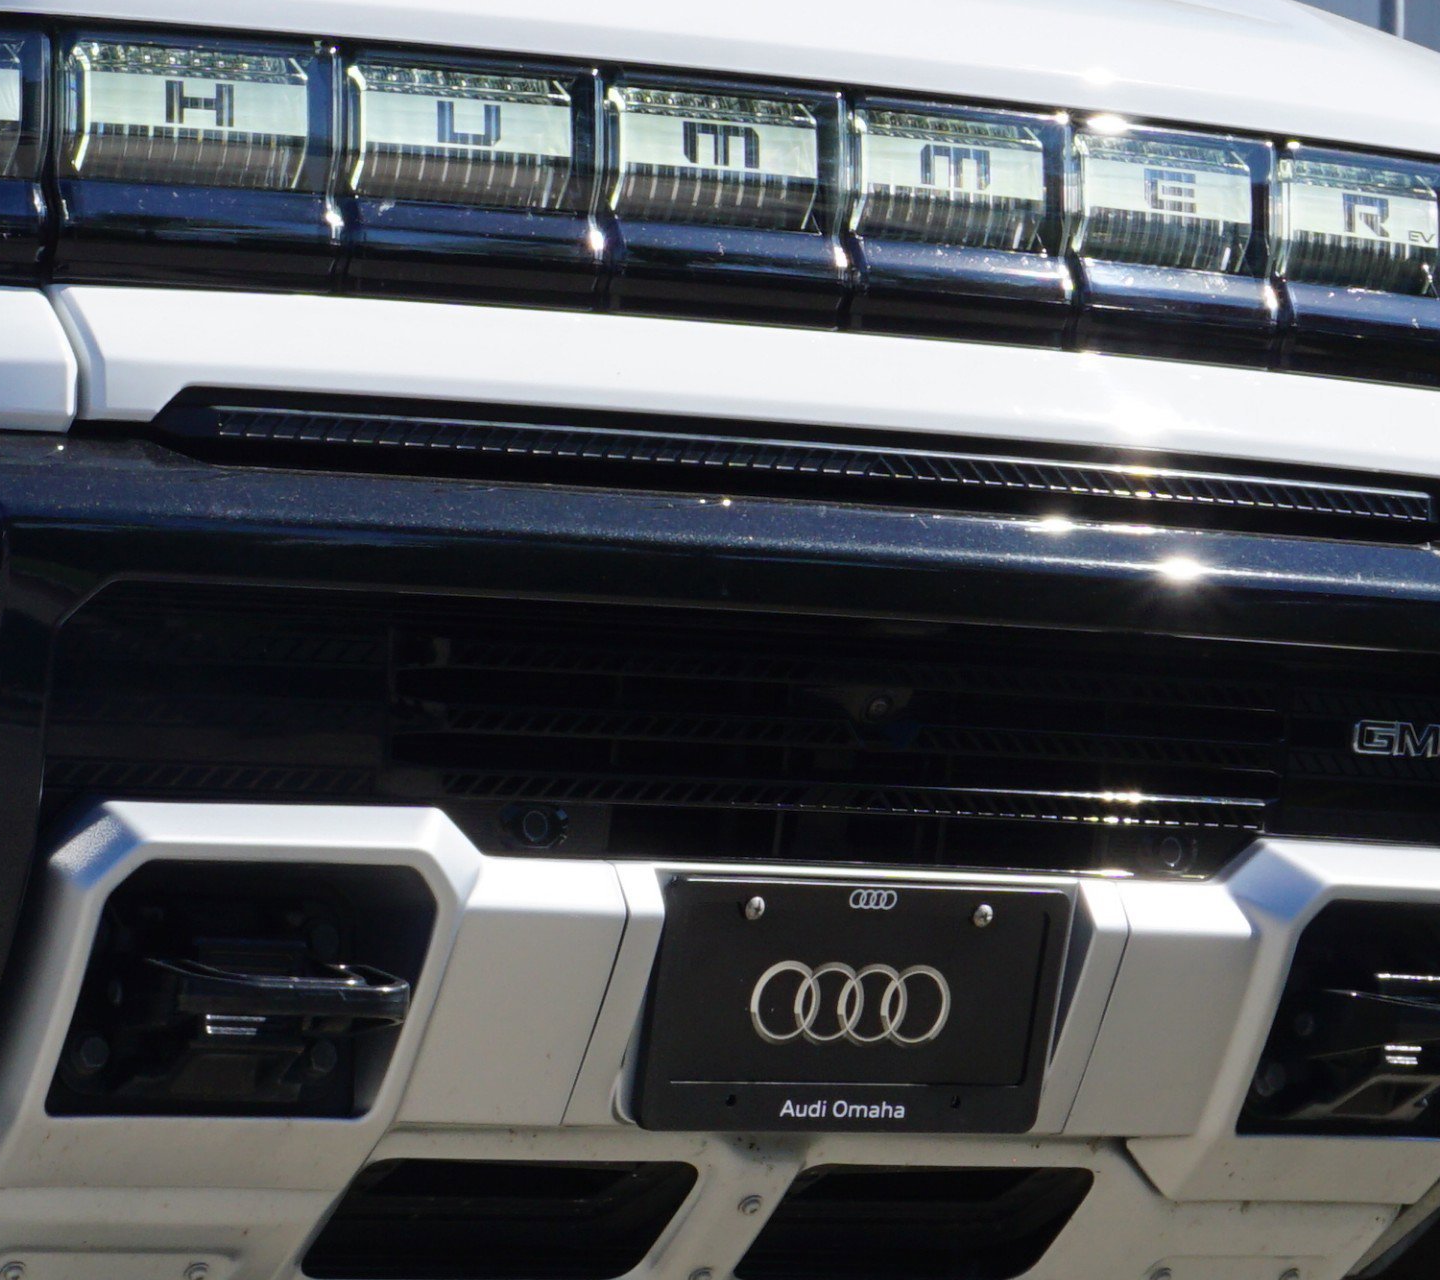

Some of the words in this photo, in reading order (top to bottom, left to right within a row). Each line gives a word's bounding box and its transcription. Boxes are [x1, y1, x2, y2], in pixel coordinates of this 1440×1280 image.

[1408, 230, 1436, 244] EV
[779, 1099, 827, 1118] Audi
[832, 1100, 906, 1119] Omaha
